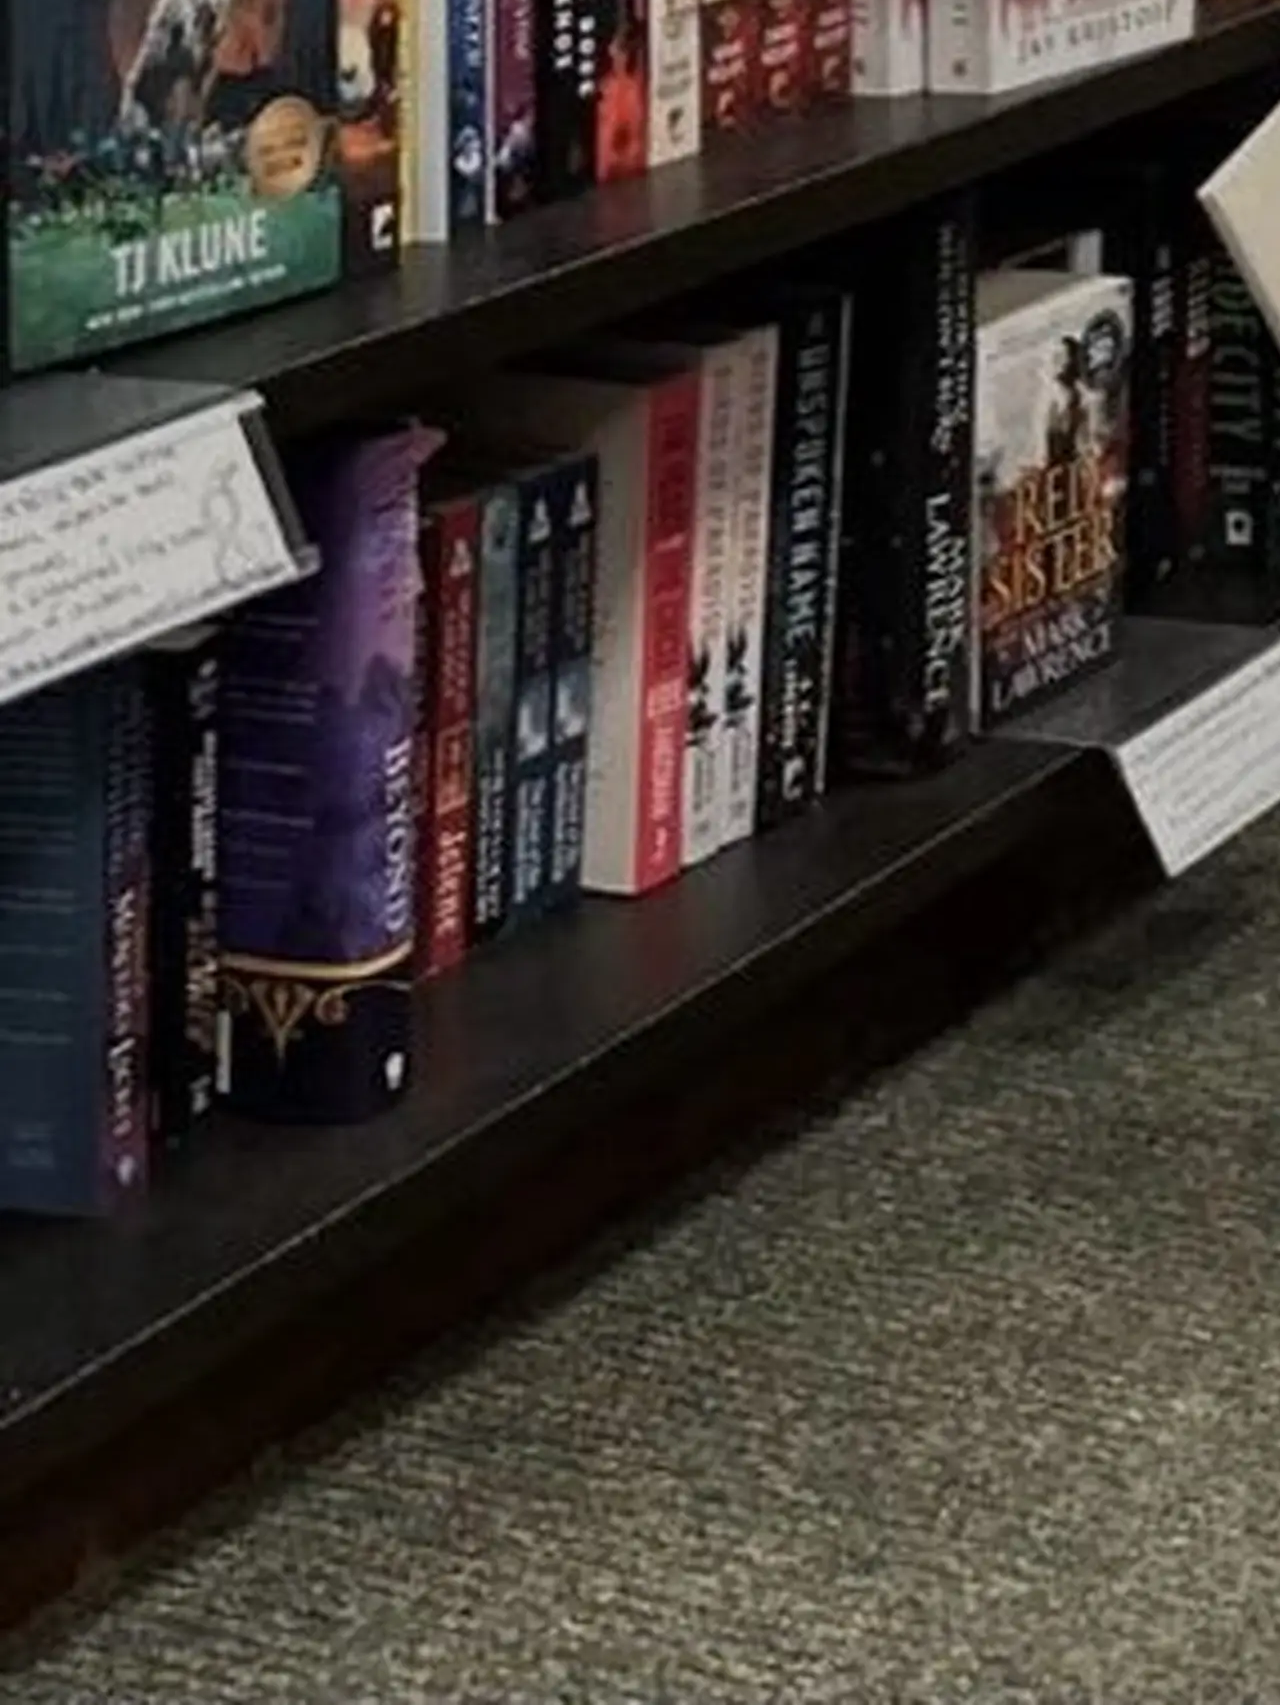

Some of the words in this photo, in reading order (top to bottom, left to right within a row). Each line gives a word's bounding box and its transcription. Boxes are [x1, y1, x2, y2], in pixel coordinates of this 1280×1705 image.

[112, 241, 150, 297] TJ
[153, 207, 269, 278] KLUNE
[791, 344, 828, 531] UNSPOKEN
[784, 539, 819, 648] NAME
[924, 492, 954, 711] LAWRENCE
[991, 510, 1118, 617] SISTER
[383, 736, 415, 934] BEYOND
